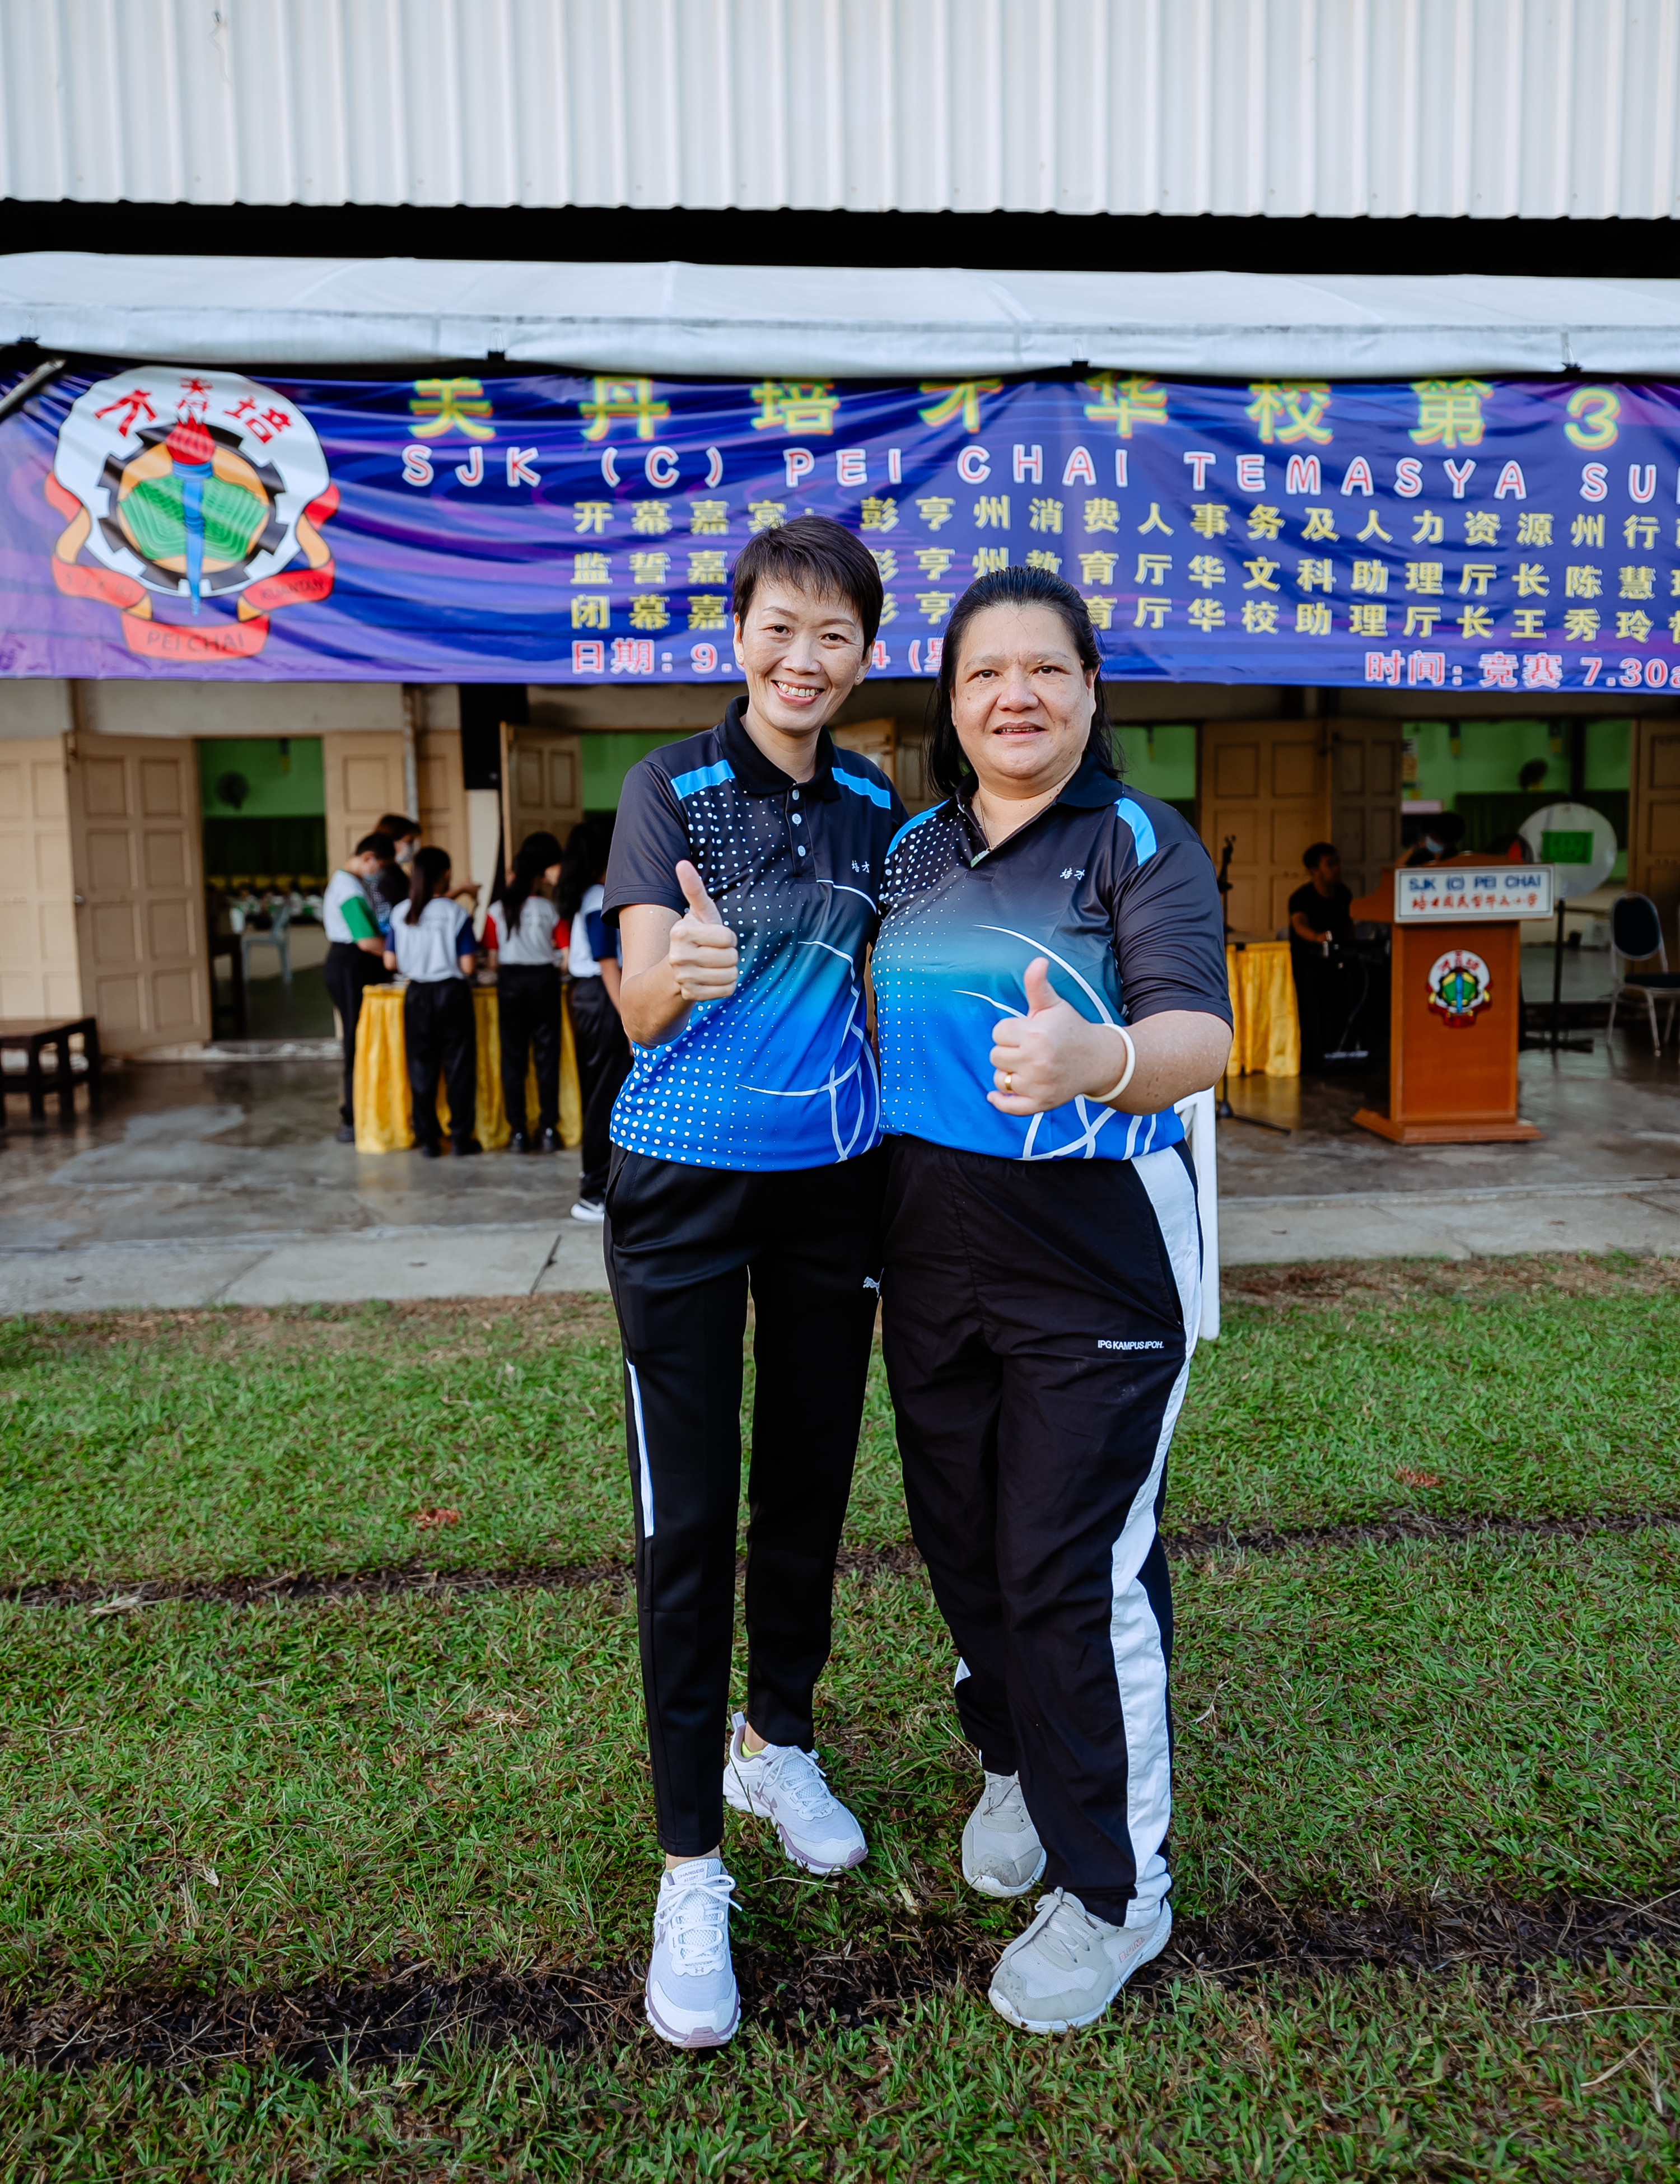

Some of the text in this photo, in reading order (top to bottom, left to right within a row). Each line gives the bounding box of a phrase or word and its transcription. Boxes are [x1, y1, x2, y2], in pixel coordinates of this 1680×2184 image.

[401, 444, 1680, 505] SJK (C) PEI CHAI TEMASYA SU
[146, 629, 245, 653] PEI CHAI
[1474, 875, 1497, 889] PEI
[1505, 873, 1542, 889] CHAI
[1097, 1340, 1112, 1349] IPG
[1113, 1341, 1145, 1351] KAMPUS
